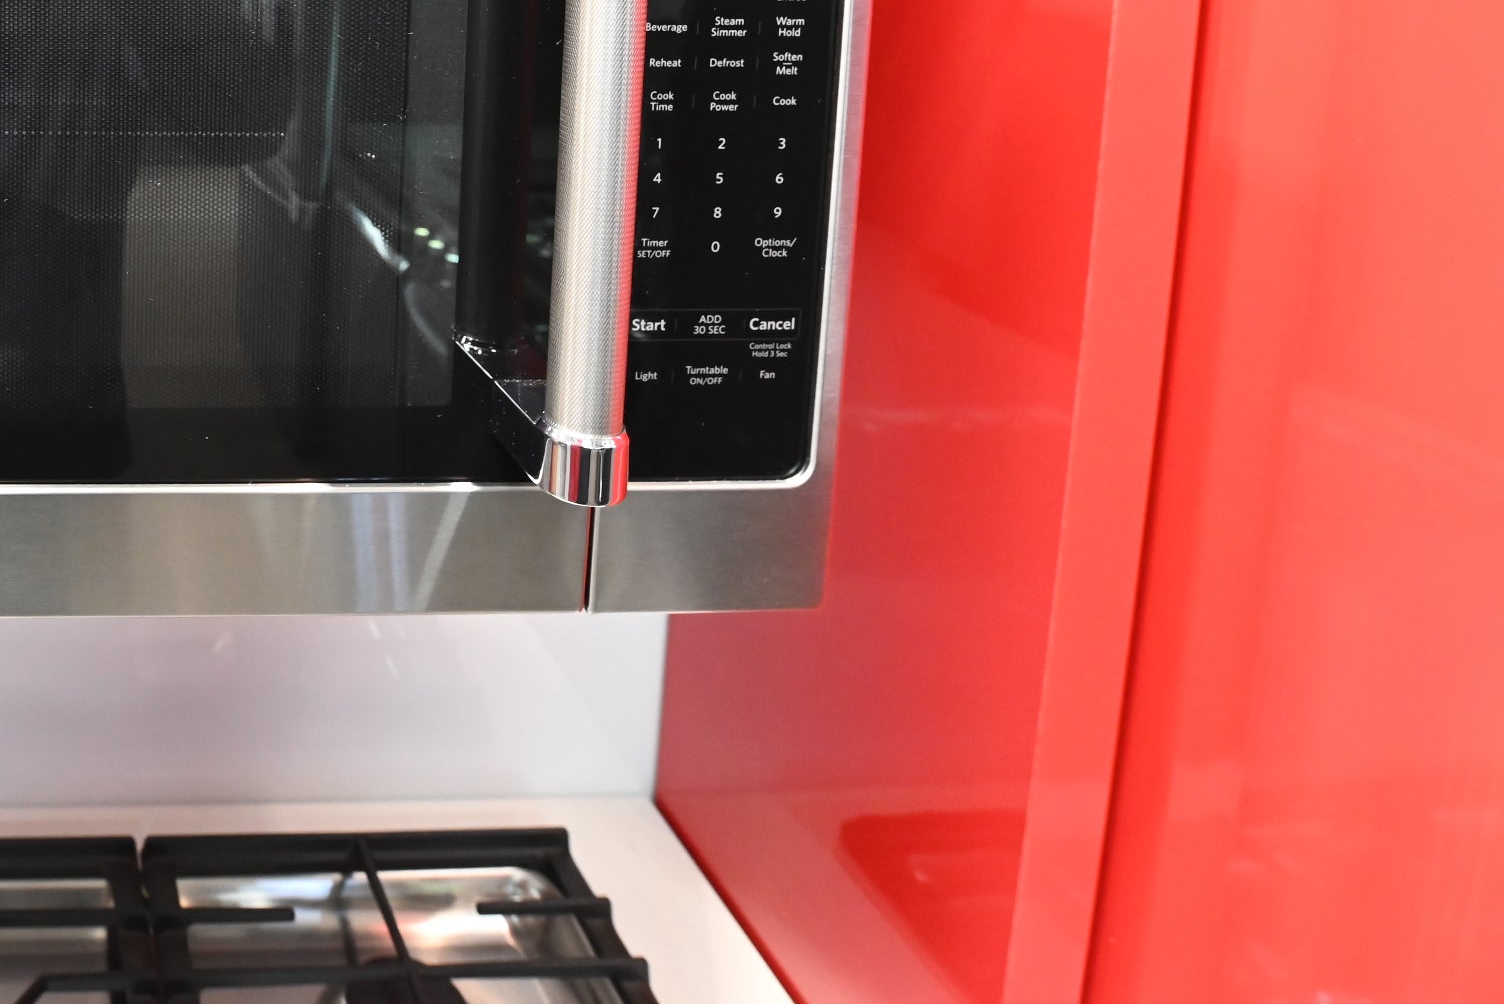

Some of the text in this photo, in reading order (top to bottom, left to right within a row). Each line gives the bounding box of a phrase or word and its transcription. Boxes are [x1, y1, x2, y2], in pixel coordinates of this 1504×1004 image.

[715, 16, 744, 25] Steam
[776, 17, 805, 25] Warm
[646, 23, 687, 33] Beverage
[711, 28, 747, 36] Simmer
[779, 28, 801, 36] Hold
[773, 52, 803, 61] Soften
[650, 58, 681, 67] Reheat
[710, 58, 744, 67] Defrost
[776, 66, 798, 75] Melt
[650, 91, 674, 100] Cook
[713, 91, 736, 100] Cook
[773, 96, 796, 105] Cook
[650, 102, 673, 111] Time
[710, 102, 738, 111] Power
[657, 138, 661, 149] 1
[718, 138, 726, 149] 2
[778, 138, 786, 149] 3
[653, 173, 661, 183] 4
[716, 173, 723, 184] 5
[776, 173, 784, 184] 6
[652, 207, 659, 218] 7
[714, 207, 721, 218] 8
[774, 207, 782, 218] 9
[641, 238, 668, 247] Timer
[711, 241, 720, 252] 0
[754, 237, 797, 249] Options/
[637, 250, 671, 258] SET/OFF
[762, 248, 787, 257] Clock
[699, 315, 721, 323] ADD
[632, 319, 666, 332] Start
[749, 318, 795, 330] Cancel
[694, 326, 725, 334] 30 SEC
[686, 366, 728, 374] Turntable
[760, 370, 775, 378] Fan
[635, 371, 657, 381] Light
[690, 377, 722, 385] ON/OFF
